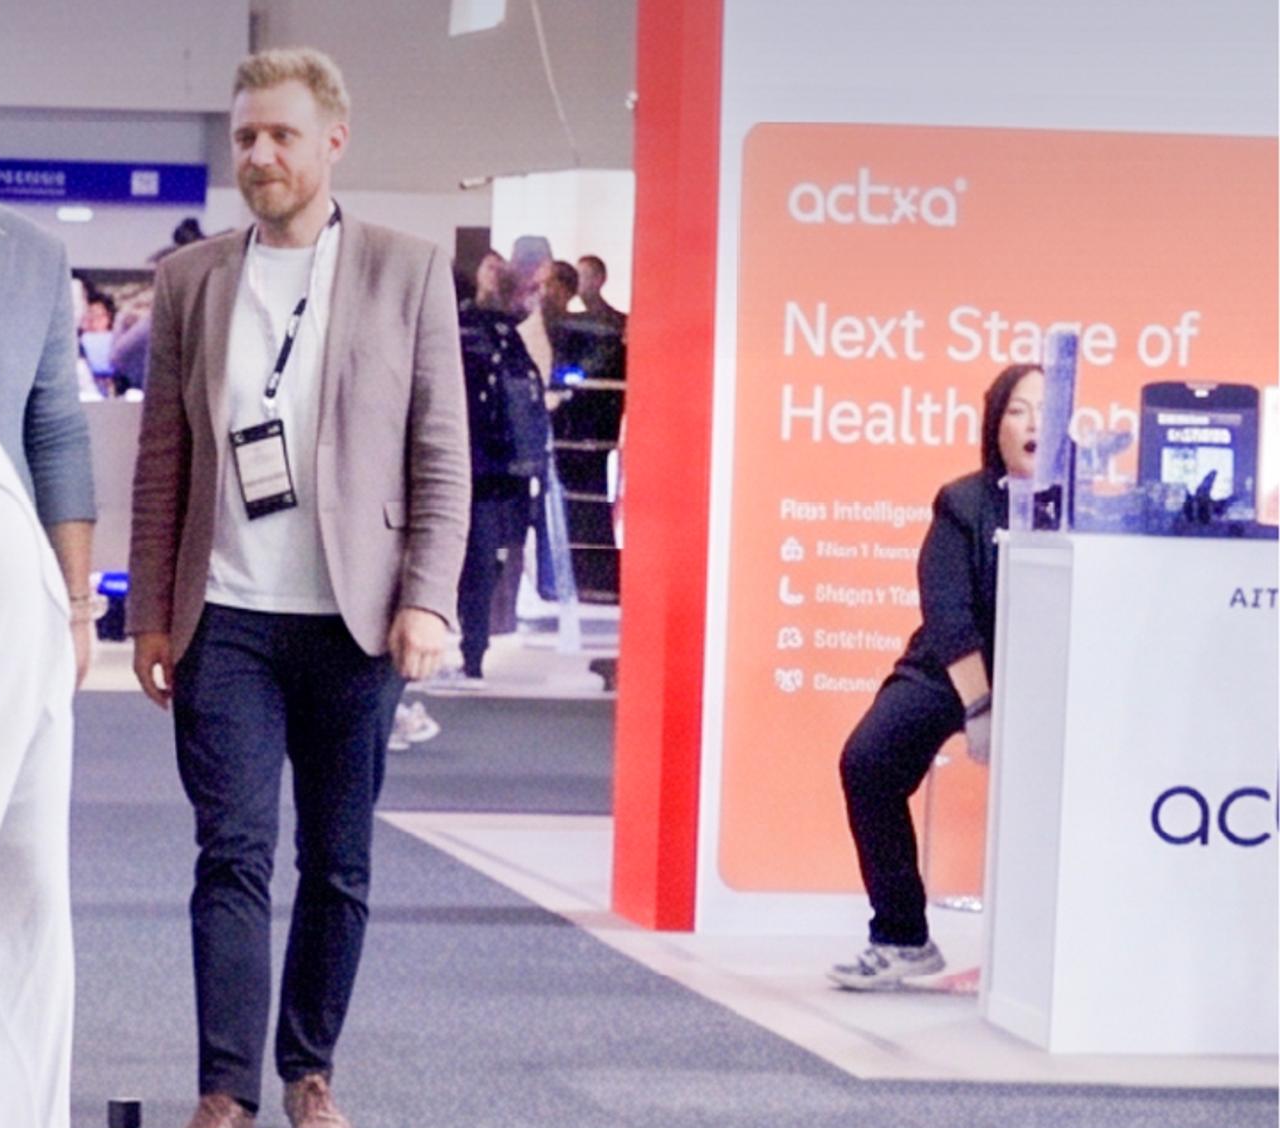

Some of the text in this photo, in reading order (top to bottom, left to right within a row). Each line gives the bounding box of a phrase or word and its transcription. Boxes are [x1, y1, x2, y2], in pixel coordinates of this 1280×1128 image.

[783, 301, 925, 360] Next
[1137, 310, 1201, 368] of
[780, 385, 980, 445] Health
[1150, 784, 1279, 848] ac
